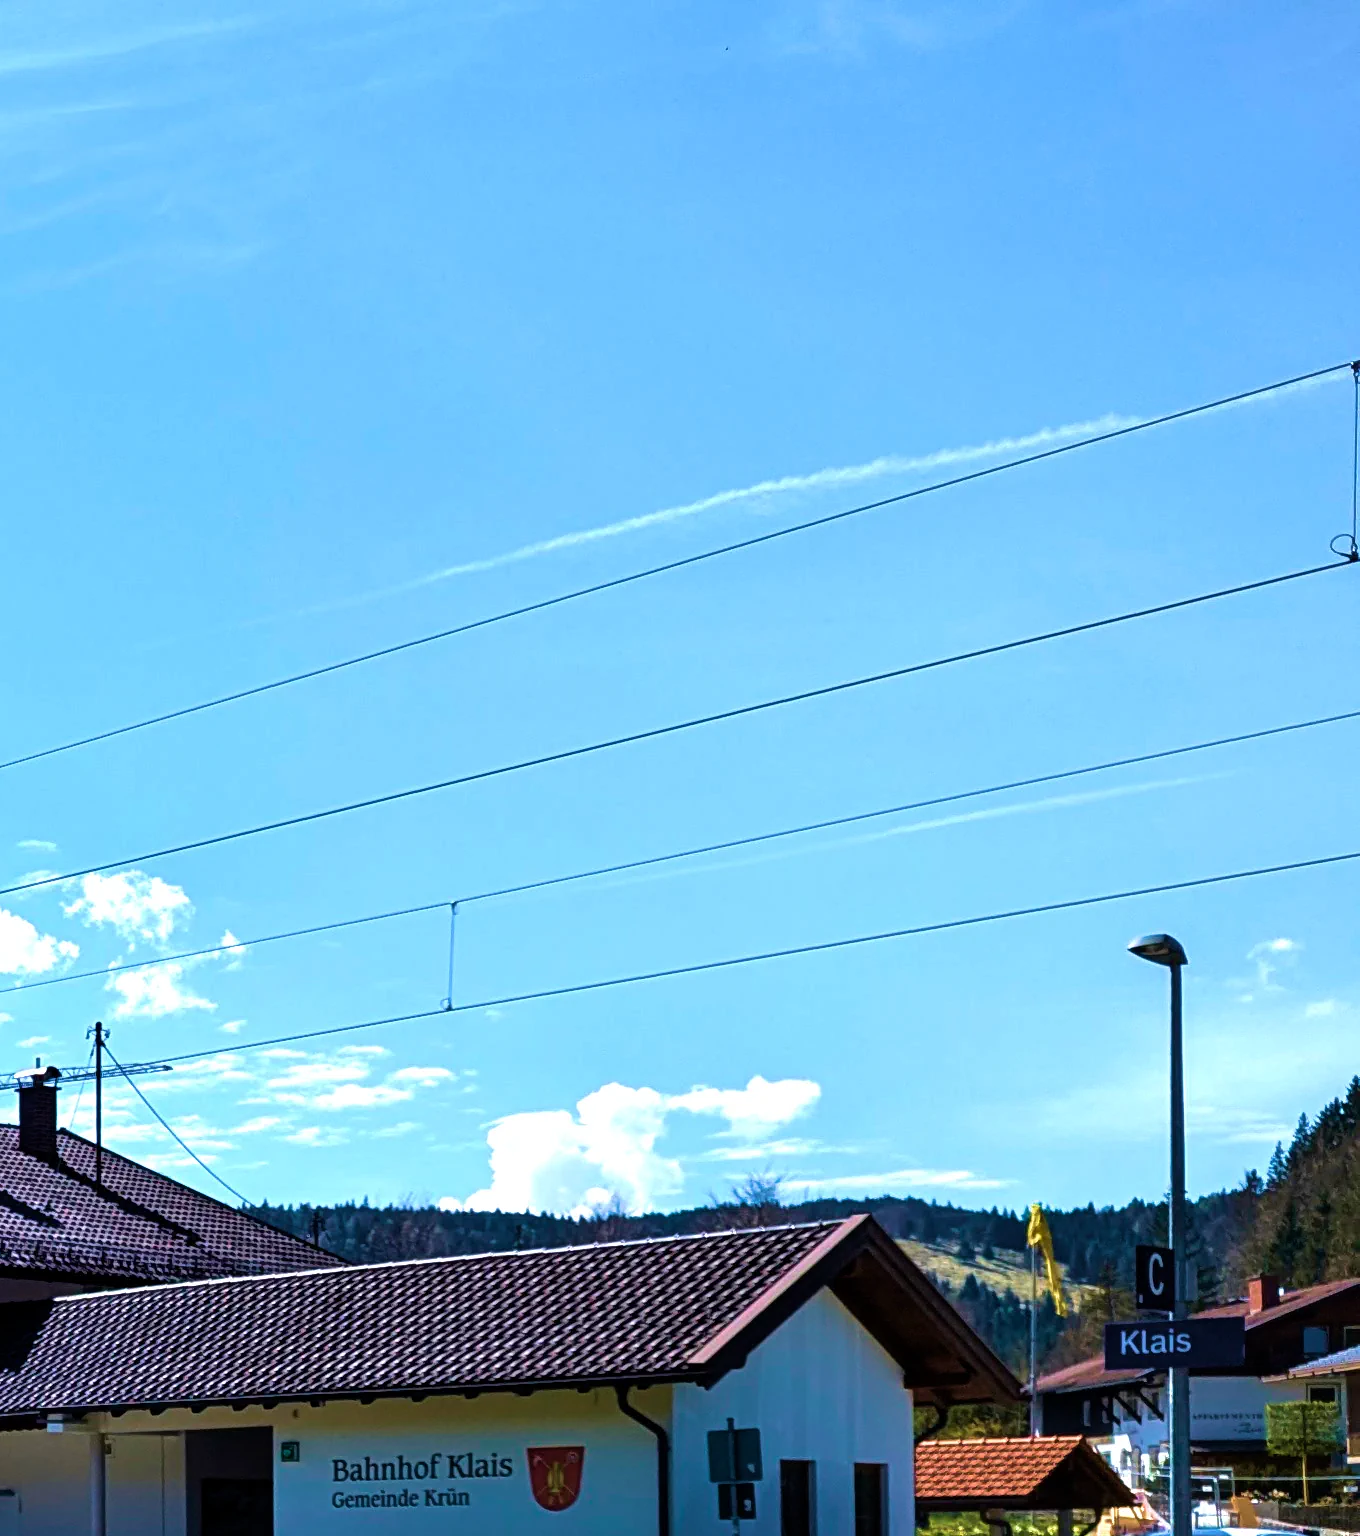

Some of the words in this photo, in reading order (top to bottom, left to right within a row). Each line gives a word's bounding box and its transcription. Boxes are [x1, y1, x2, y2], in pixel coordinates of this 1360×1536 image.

[1148, 1252, 1164, 1296] C
[1120, 1328, 1192, 1356] Klais
[332, 1453, 442, 1483] Bahnhof
[448, 1452, 513, 1480] Klais
[332, 1488, 419, 1508] Gemeinde
[424, 1488, 470, 1507] Krün
